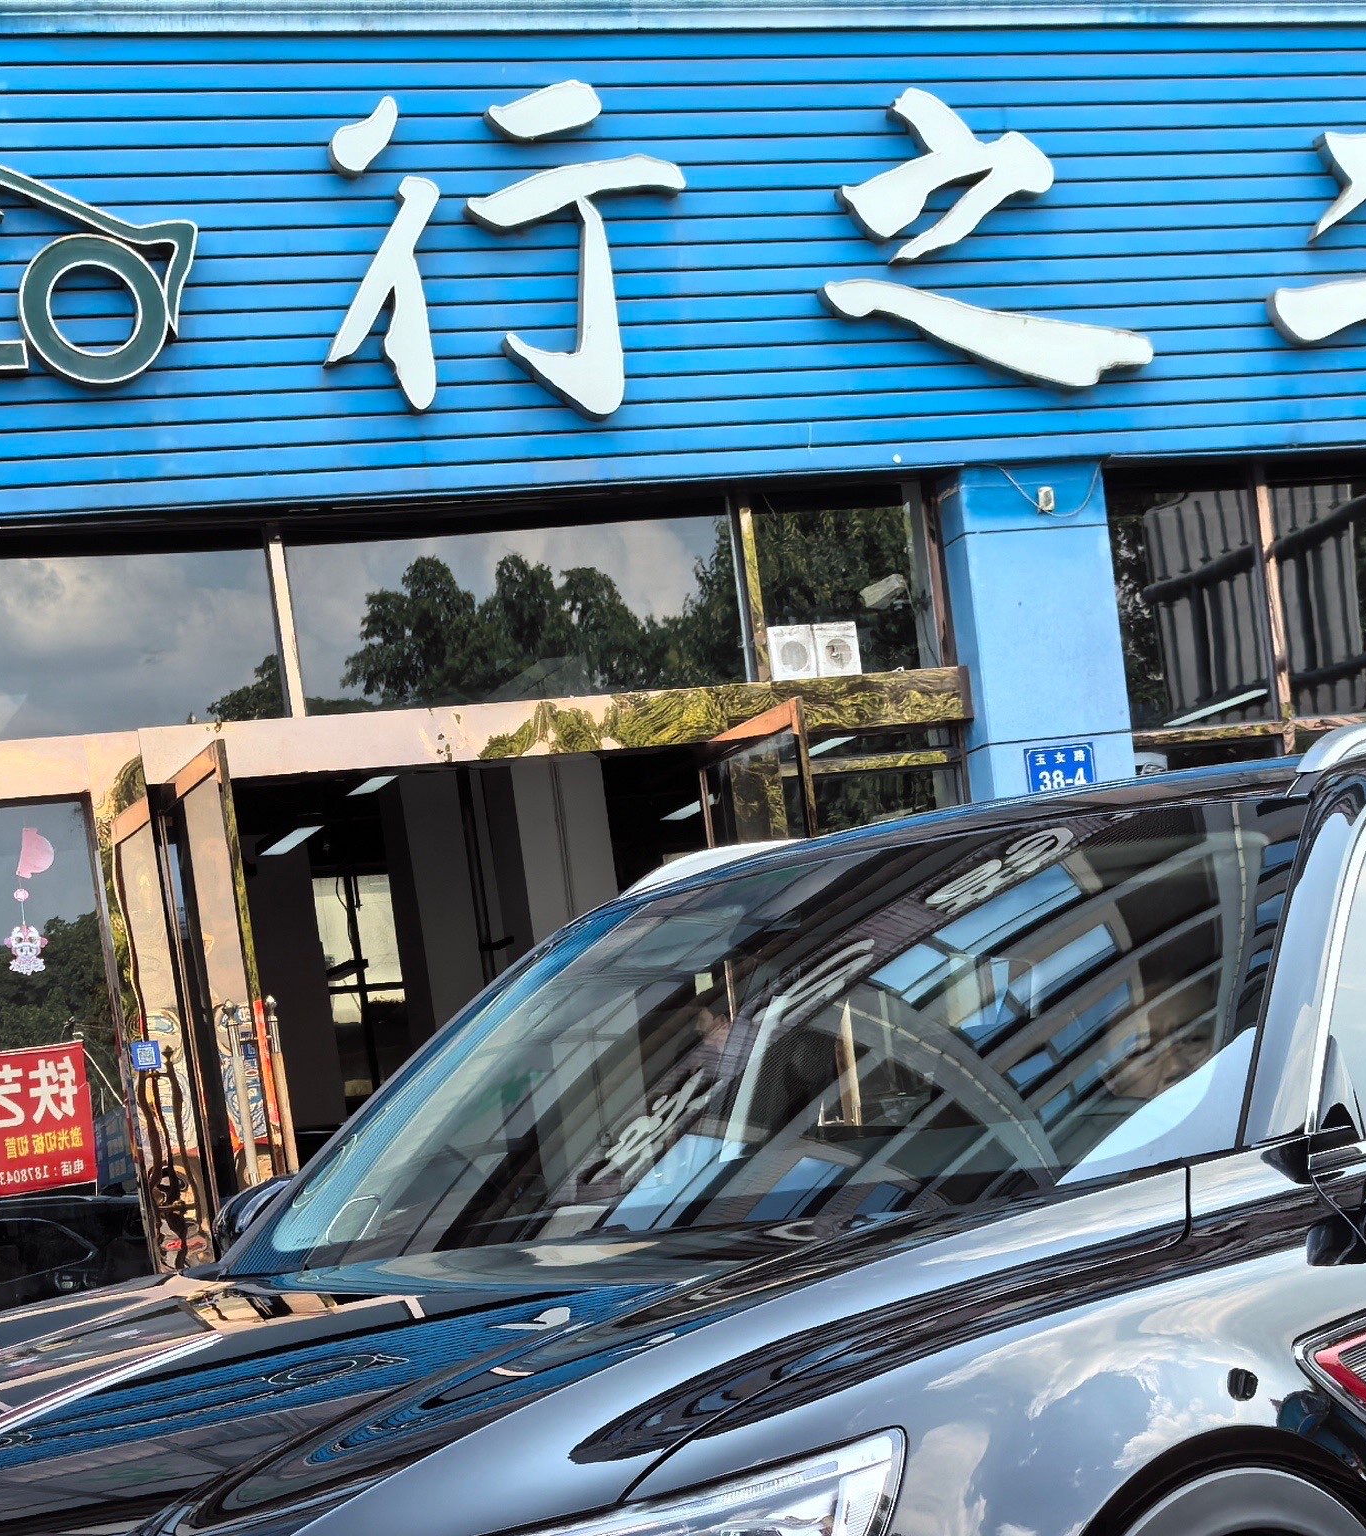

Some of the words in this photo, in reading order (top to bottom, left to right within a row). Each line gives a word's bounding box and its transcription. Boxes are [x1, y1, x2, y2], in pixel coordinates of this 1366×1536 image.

[1035, 749, 1086, 766] 玉女路
[1038, 767, 1087, 792] 38-4
